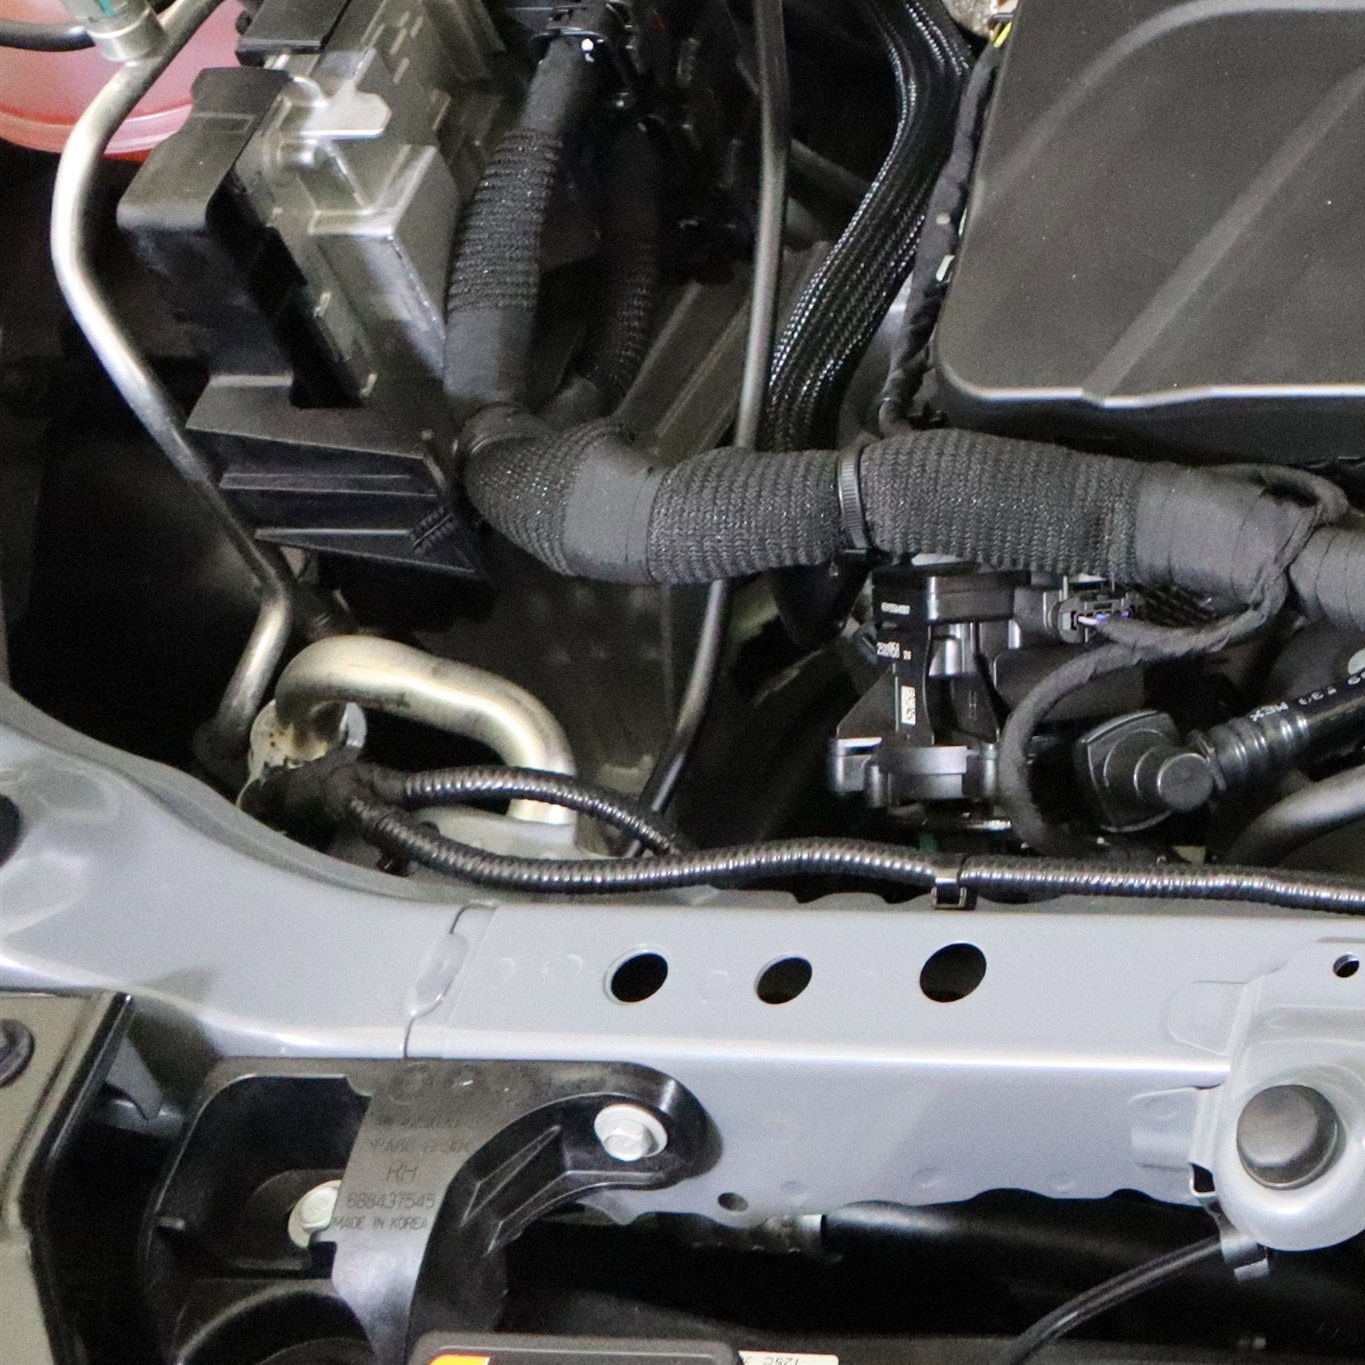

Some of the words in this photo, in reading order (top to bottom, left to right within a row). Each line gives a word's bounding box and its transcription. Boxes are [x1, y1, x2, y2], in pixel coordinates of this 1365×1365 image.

[1250, 700, 1290, 722] MEX
[384, 1164, 419, 1183] RH
[332, 1215, 366, 1231] MADE
[372, 1215, 385, 1230] IN
[390, 1215, 428, 1231] KOREA
